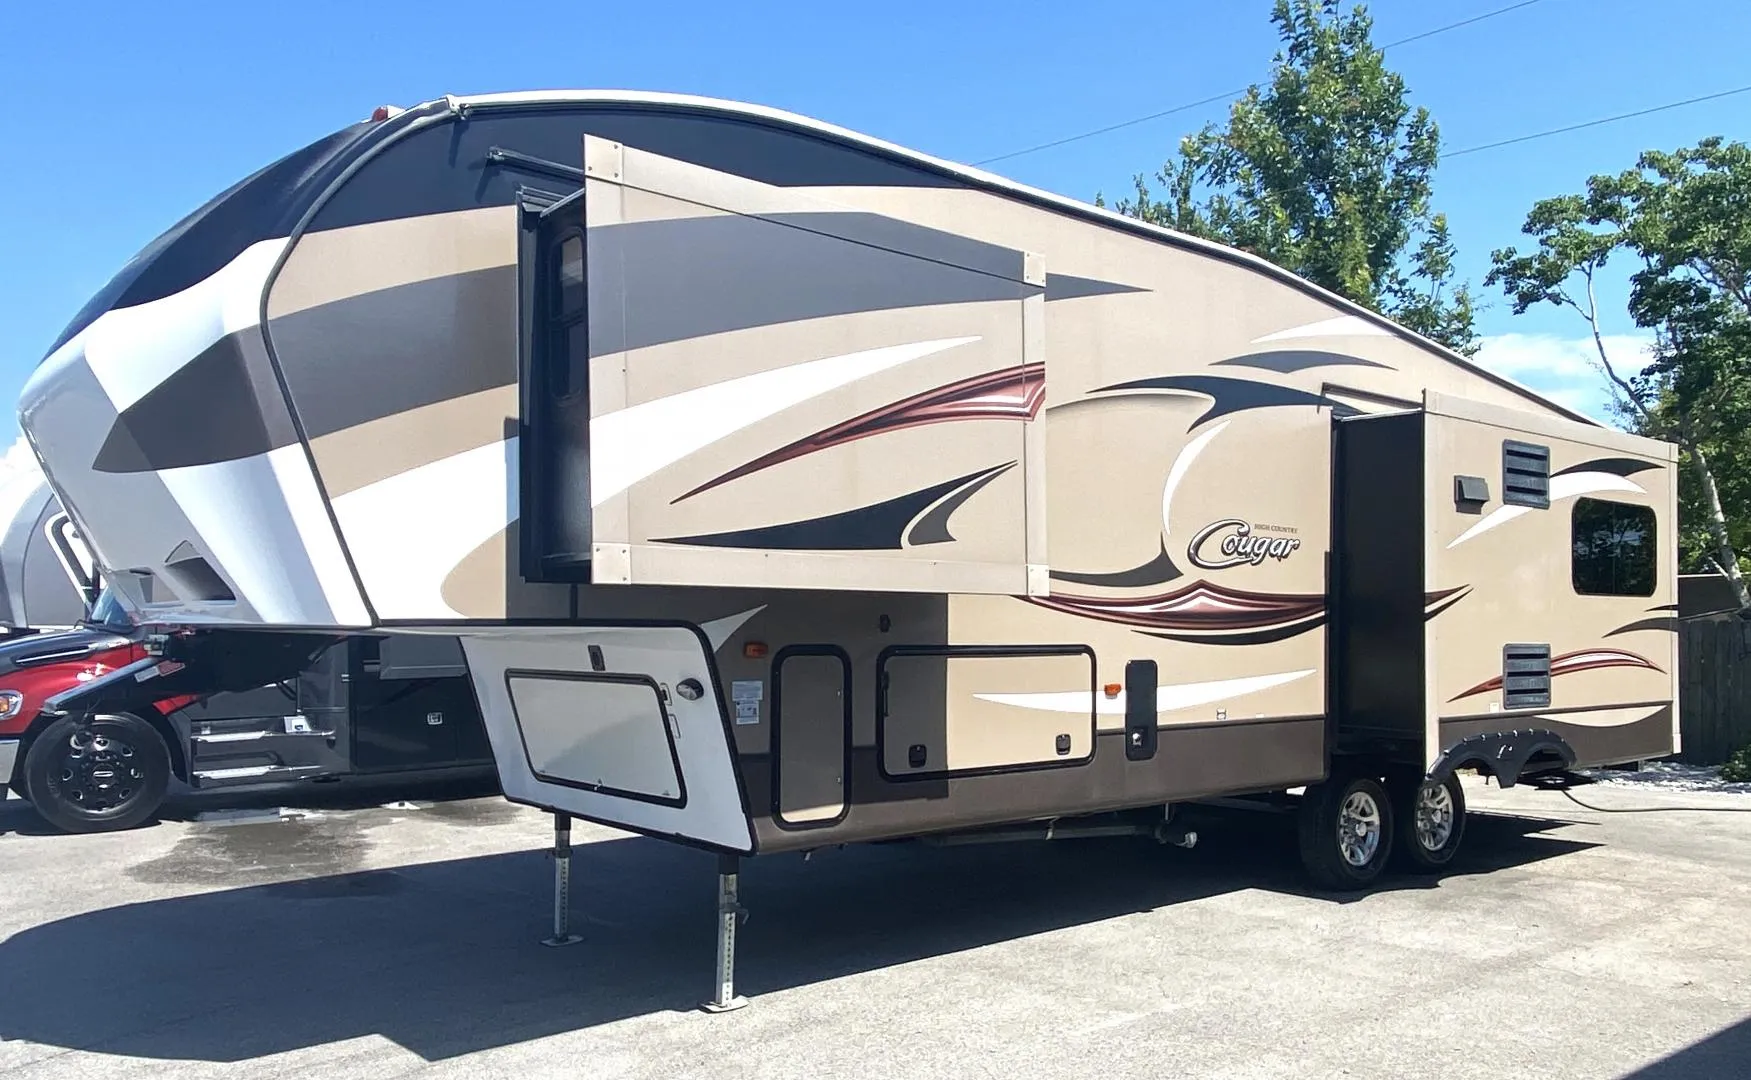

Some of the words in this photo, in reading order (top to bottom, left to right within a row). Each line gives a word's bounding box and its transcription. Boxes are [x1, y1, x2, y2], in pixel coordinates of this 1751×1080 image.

[1254, 523, 1270, 531] HIGH
[1271, 525, 1298, 534] COUNTRY
[1187, 519, 1300, 569] Cougar
